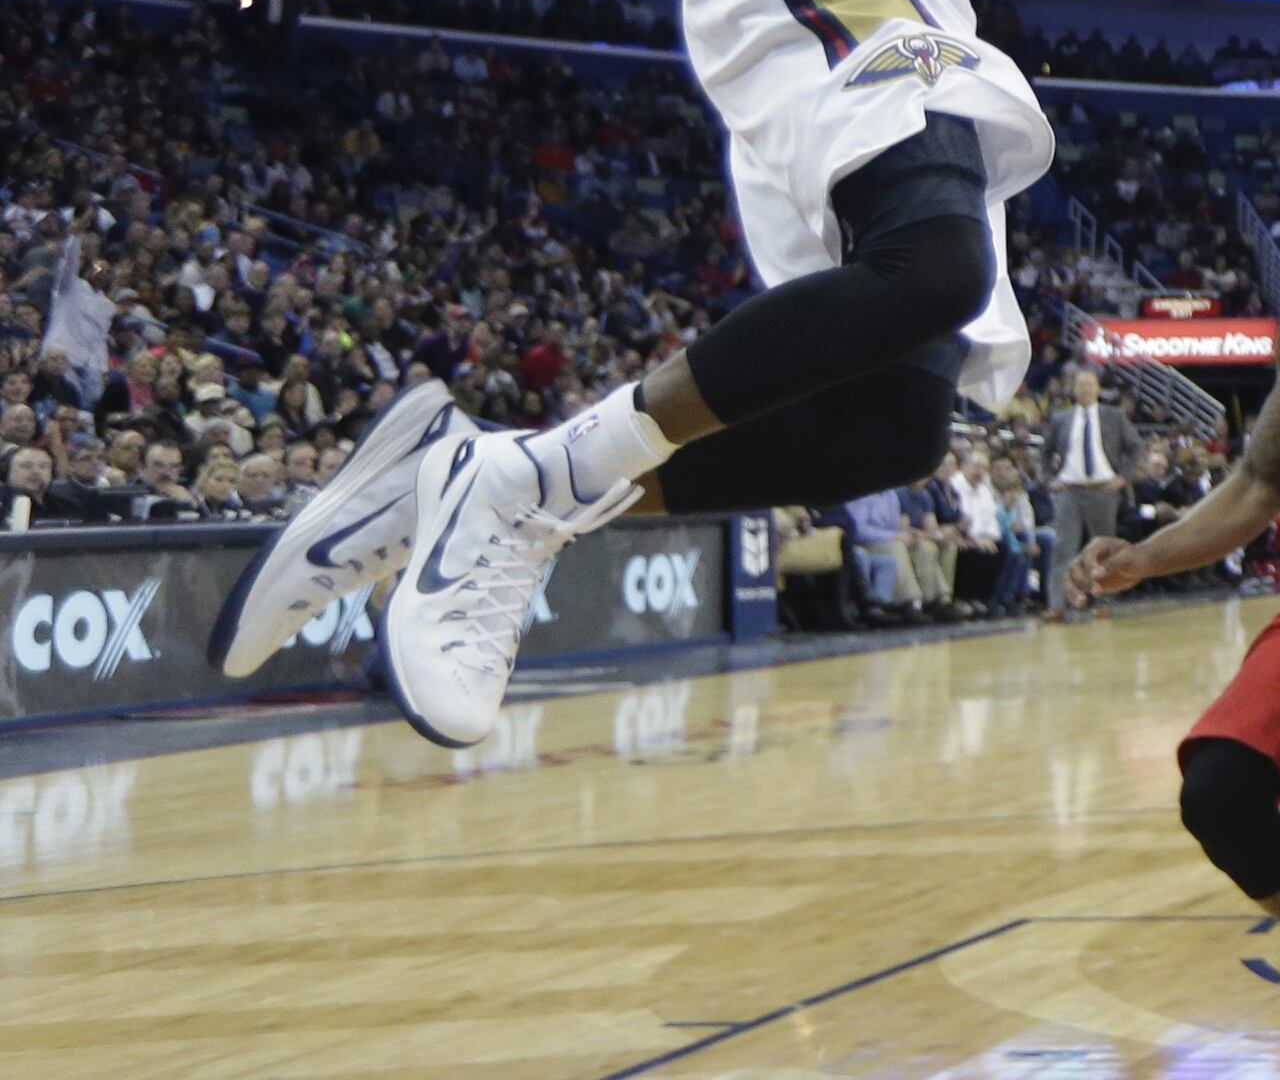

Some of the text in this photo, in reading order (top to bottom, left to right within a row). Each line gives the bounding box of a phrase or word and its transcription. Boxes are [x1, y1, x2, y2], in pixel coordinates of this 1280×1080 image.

[1122, 332, 1273, 358] SMOOTHIE KING
[281, 582, 376, 654] OX
[624, 549, 702, 618] COX
[13, 577, 161, 681] COX
